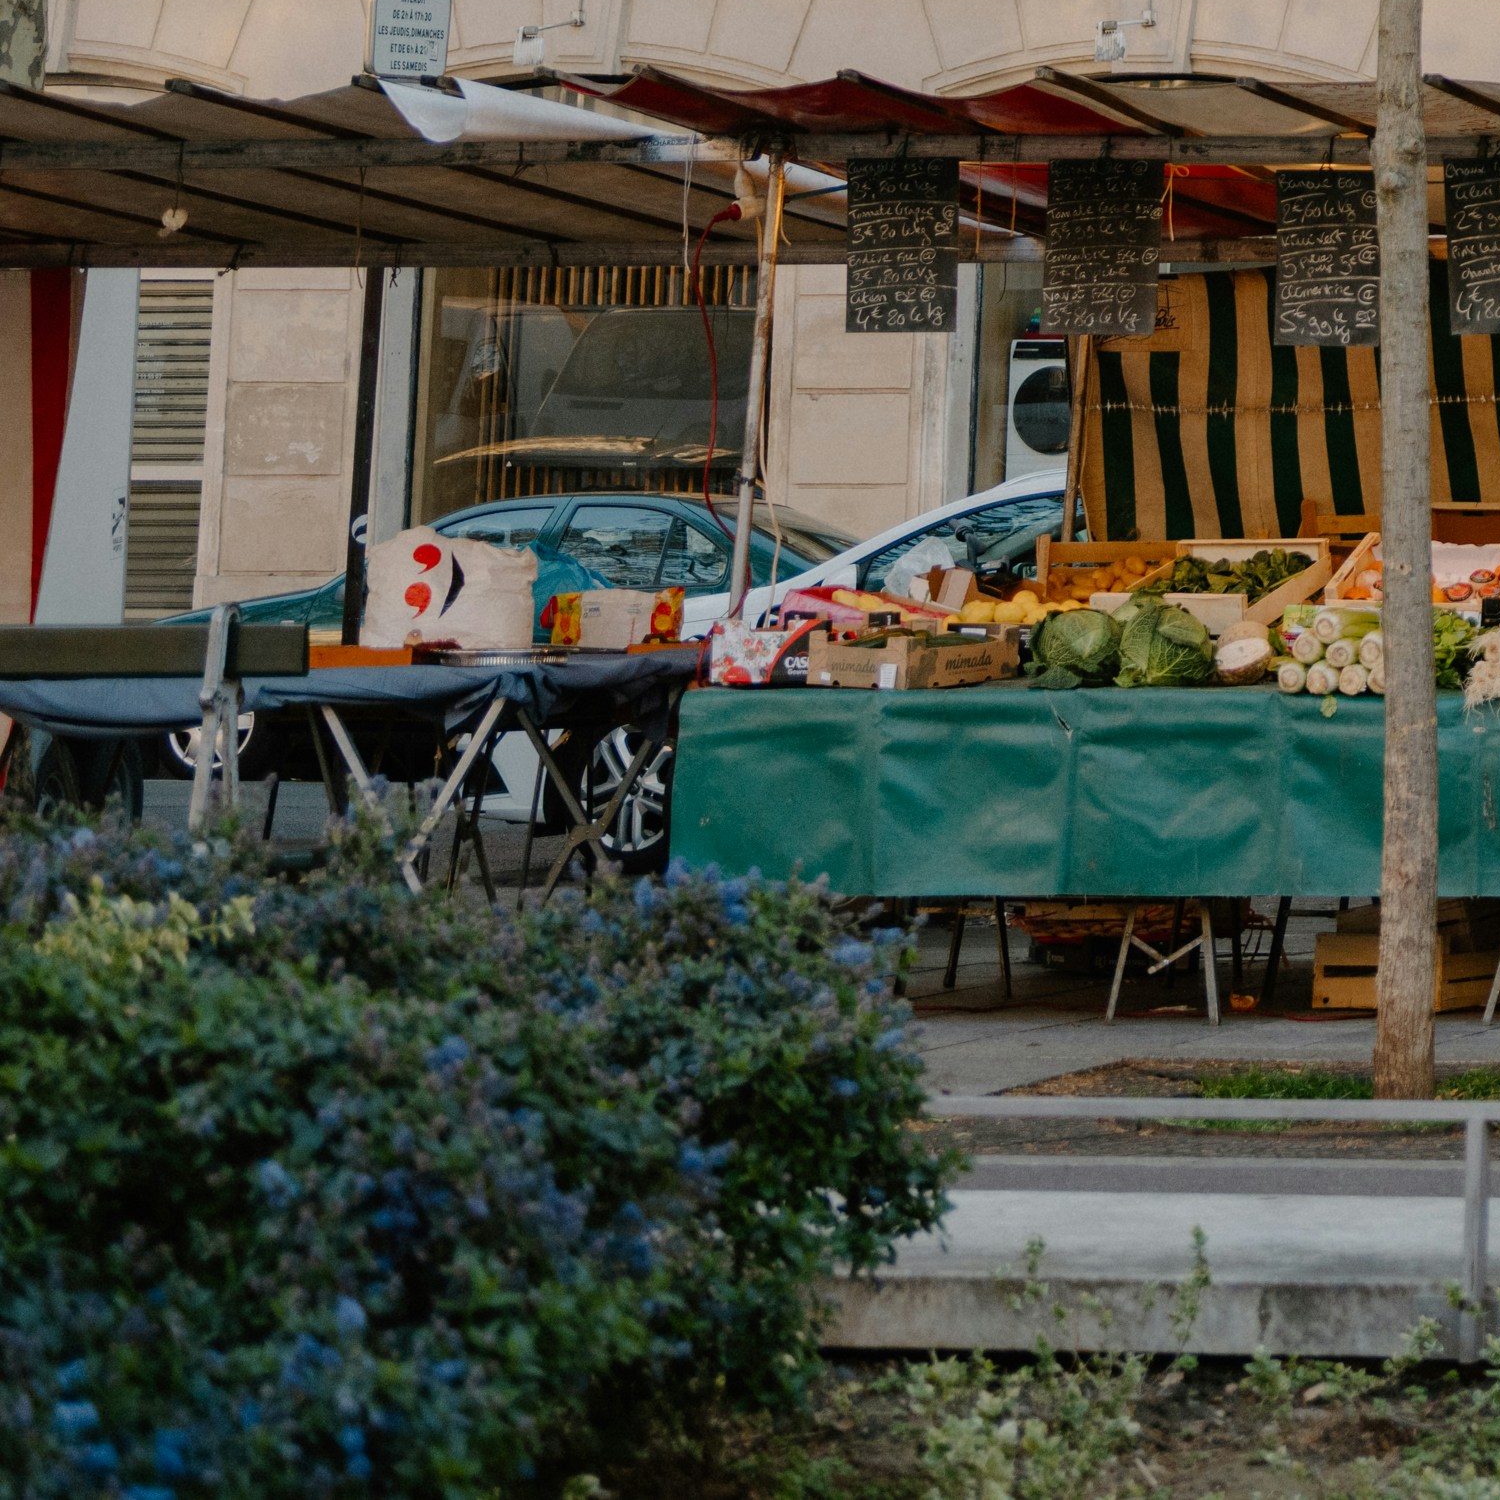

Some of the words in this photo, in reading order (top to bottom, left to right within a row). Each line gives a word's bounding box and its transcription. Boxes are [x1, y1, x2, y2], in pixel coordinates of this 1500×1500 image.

[392, 9, 400, 19] DE
[377, 25, 388, 36] LES
[390, 43, 397, 53] ET
[398, 44, 406, 54] DE
[390, 60, 401, 70] LES
[402, 61, 428, 72] SAMEDIS
[945, 650, 993, 671] mimada
